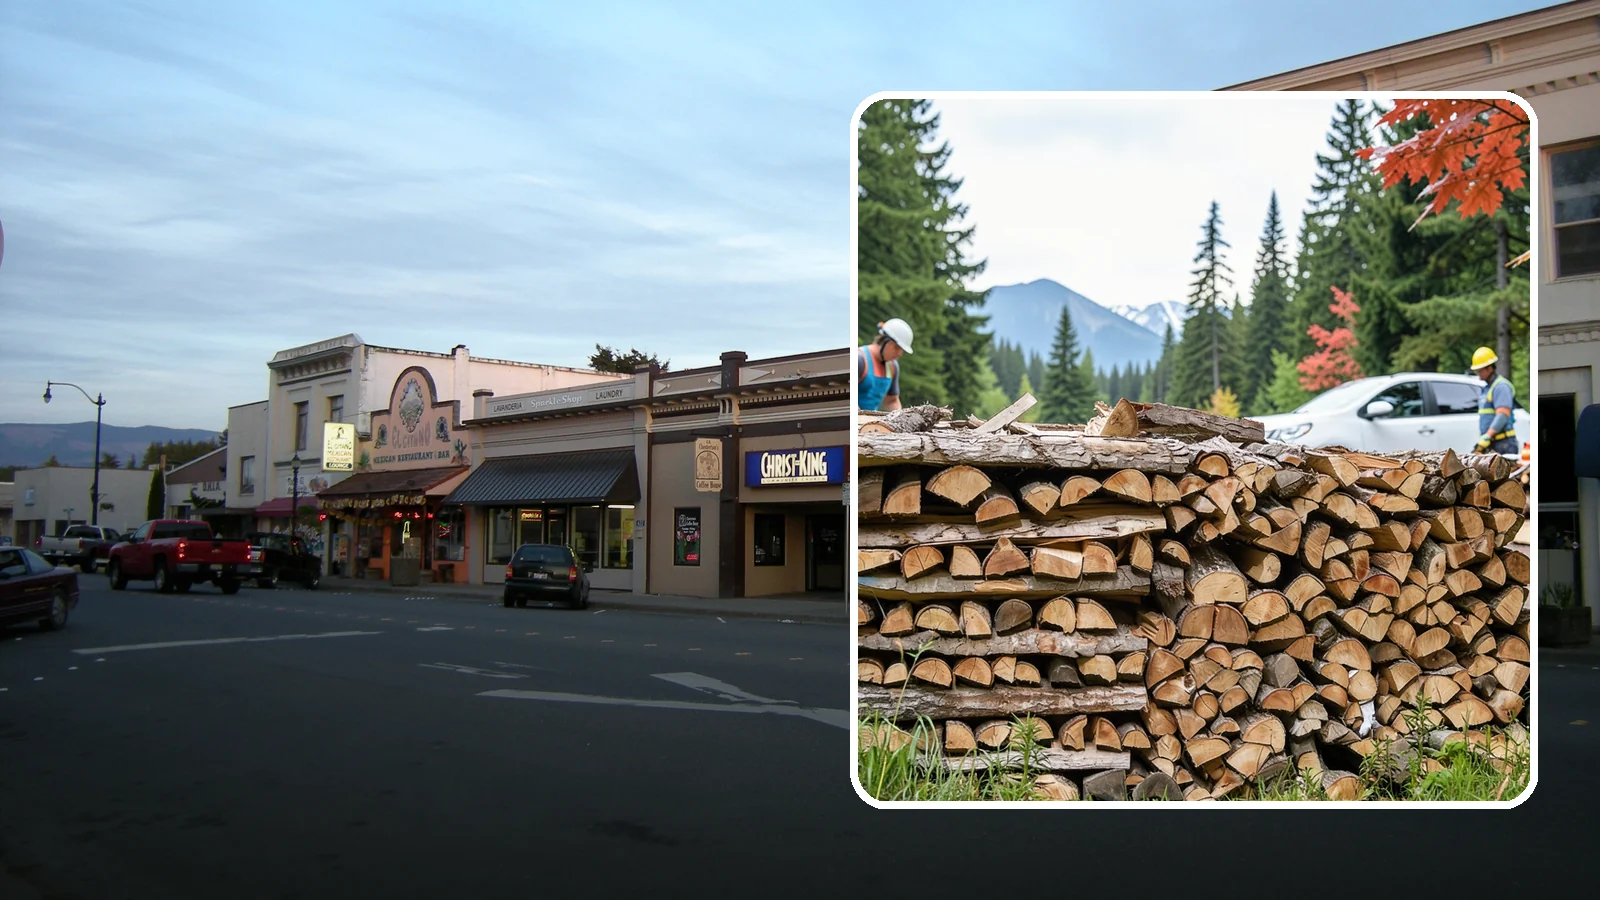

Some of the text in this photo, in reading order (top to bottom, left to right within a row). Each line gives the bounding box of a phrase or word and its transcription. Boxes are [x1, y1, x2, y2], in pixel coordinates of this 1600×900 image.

[493, 388, 624, 412] LAVANDERIA Sparkle Shop LAUNDRY
[374, 454, 396, 464] MEXICAN
[397, 451, 433, 462] RESTAURANT
[438, 450, 450, 459] BAR
[761, 450, 827, 478] CHRIST KING
